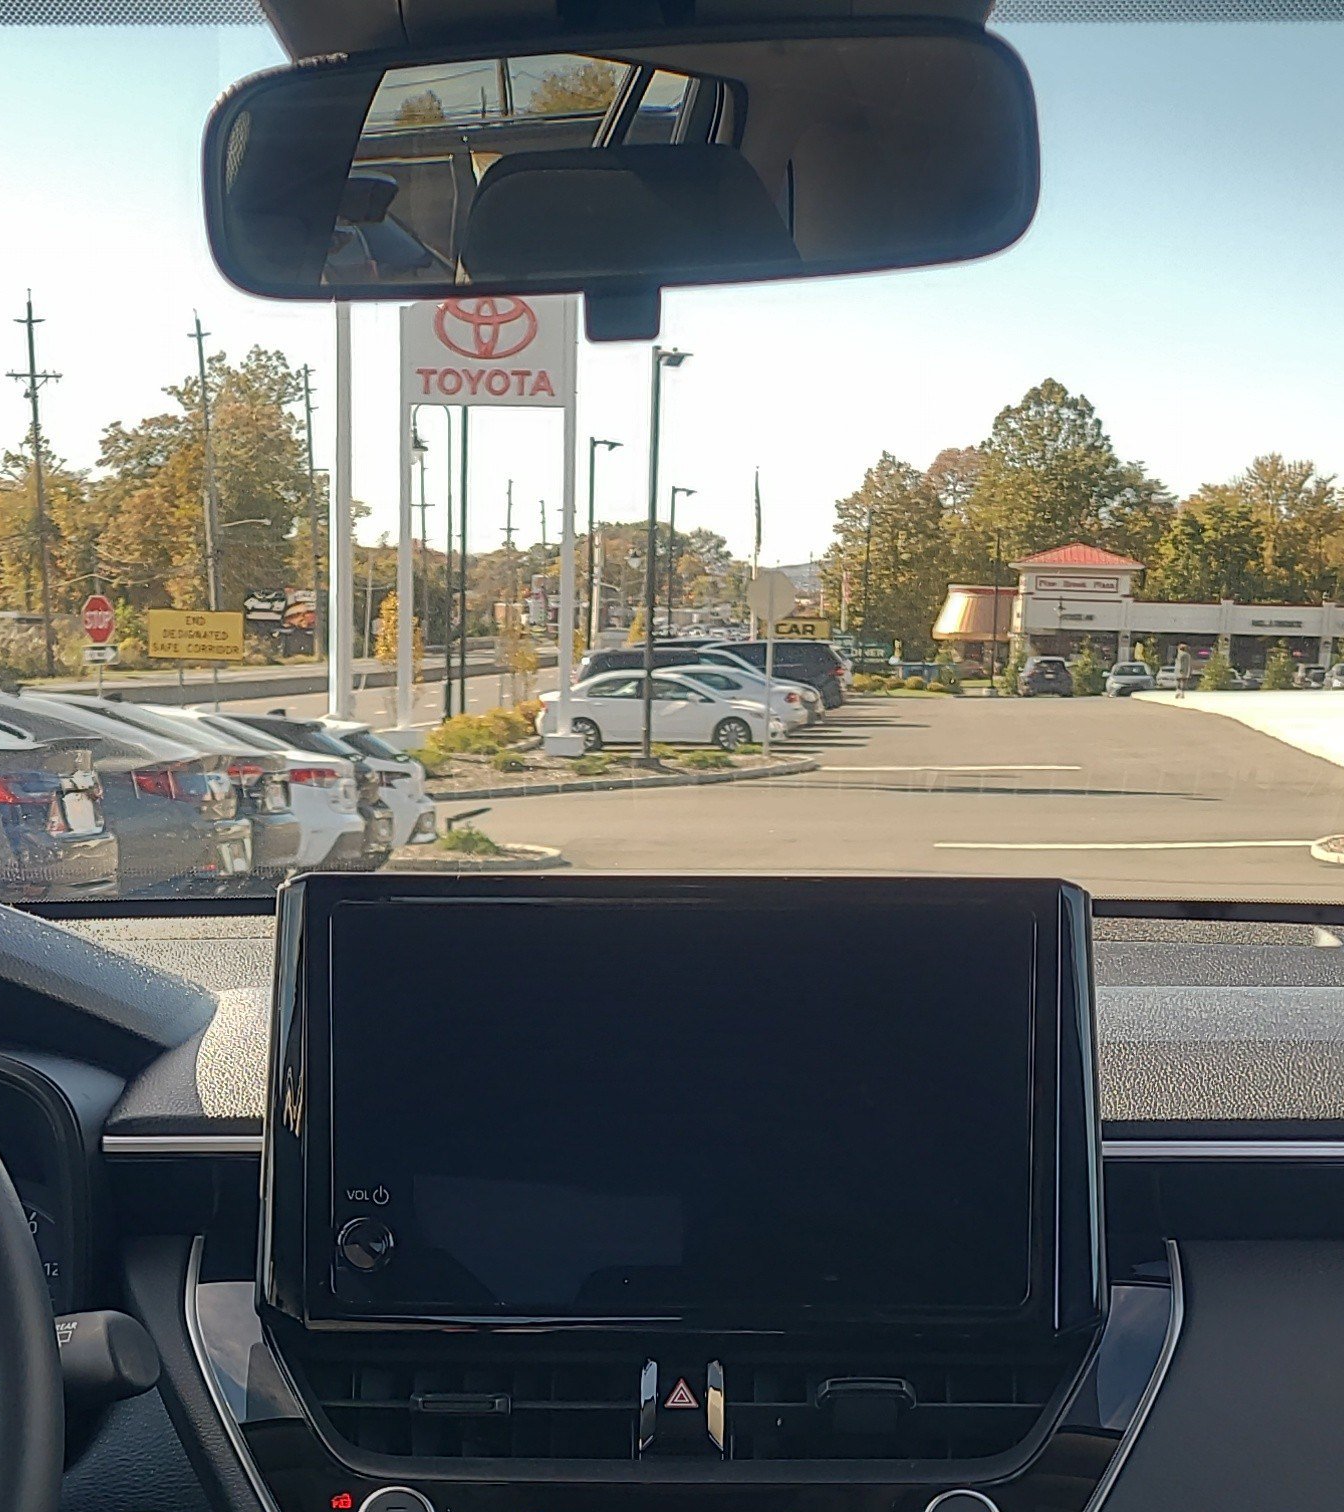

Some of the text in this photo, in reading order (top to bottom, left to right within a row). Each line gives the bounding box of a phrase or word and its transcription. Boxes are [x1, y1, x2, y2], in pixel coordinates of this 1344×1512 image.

[415, 368, 555, 397] TOYOTA
[85, 610, 113, 629] STOP
[185, 615, 206, 626] END
[163, 629, 229, 641] DESIGNATED
[775, 623, 816, 636] CAR
[153, 642, 240, 655] SAFE CORRIDOR
[346, 1190, 370, 1200] VOL
[44, 1263, 59, 1276] 12
